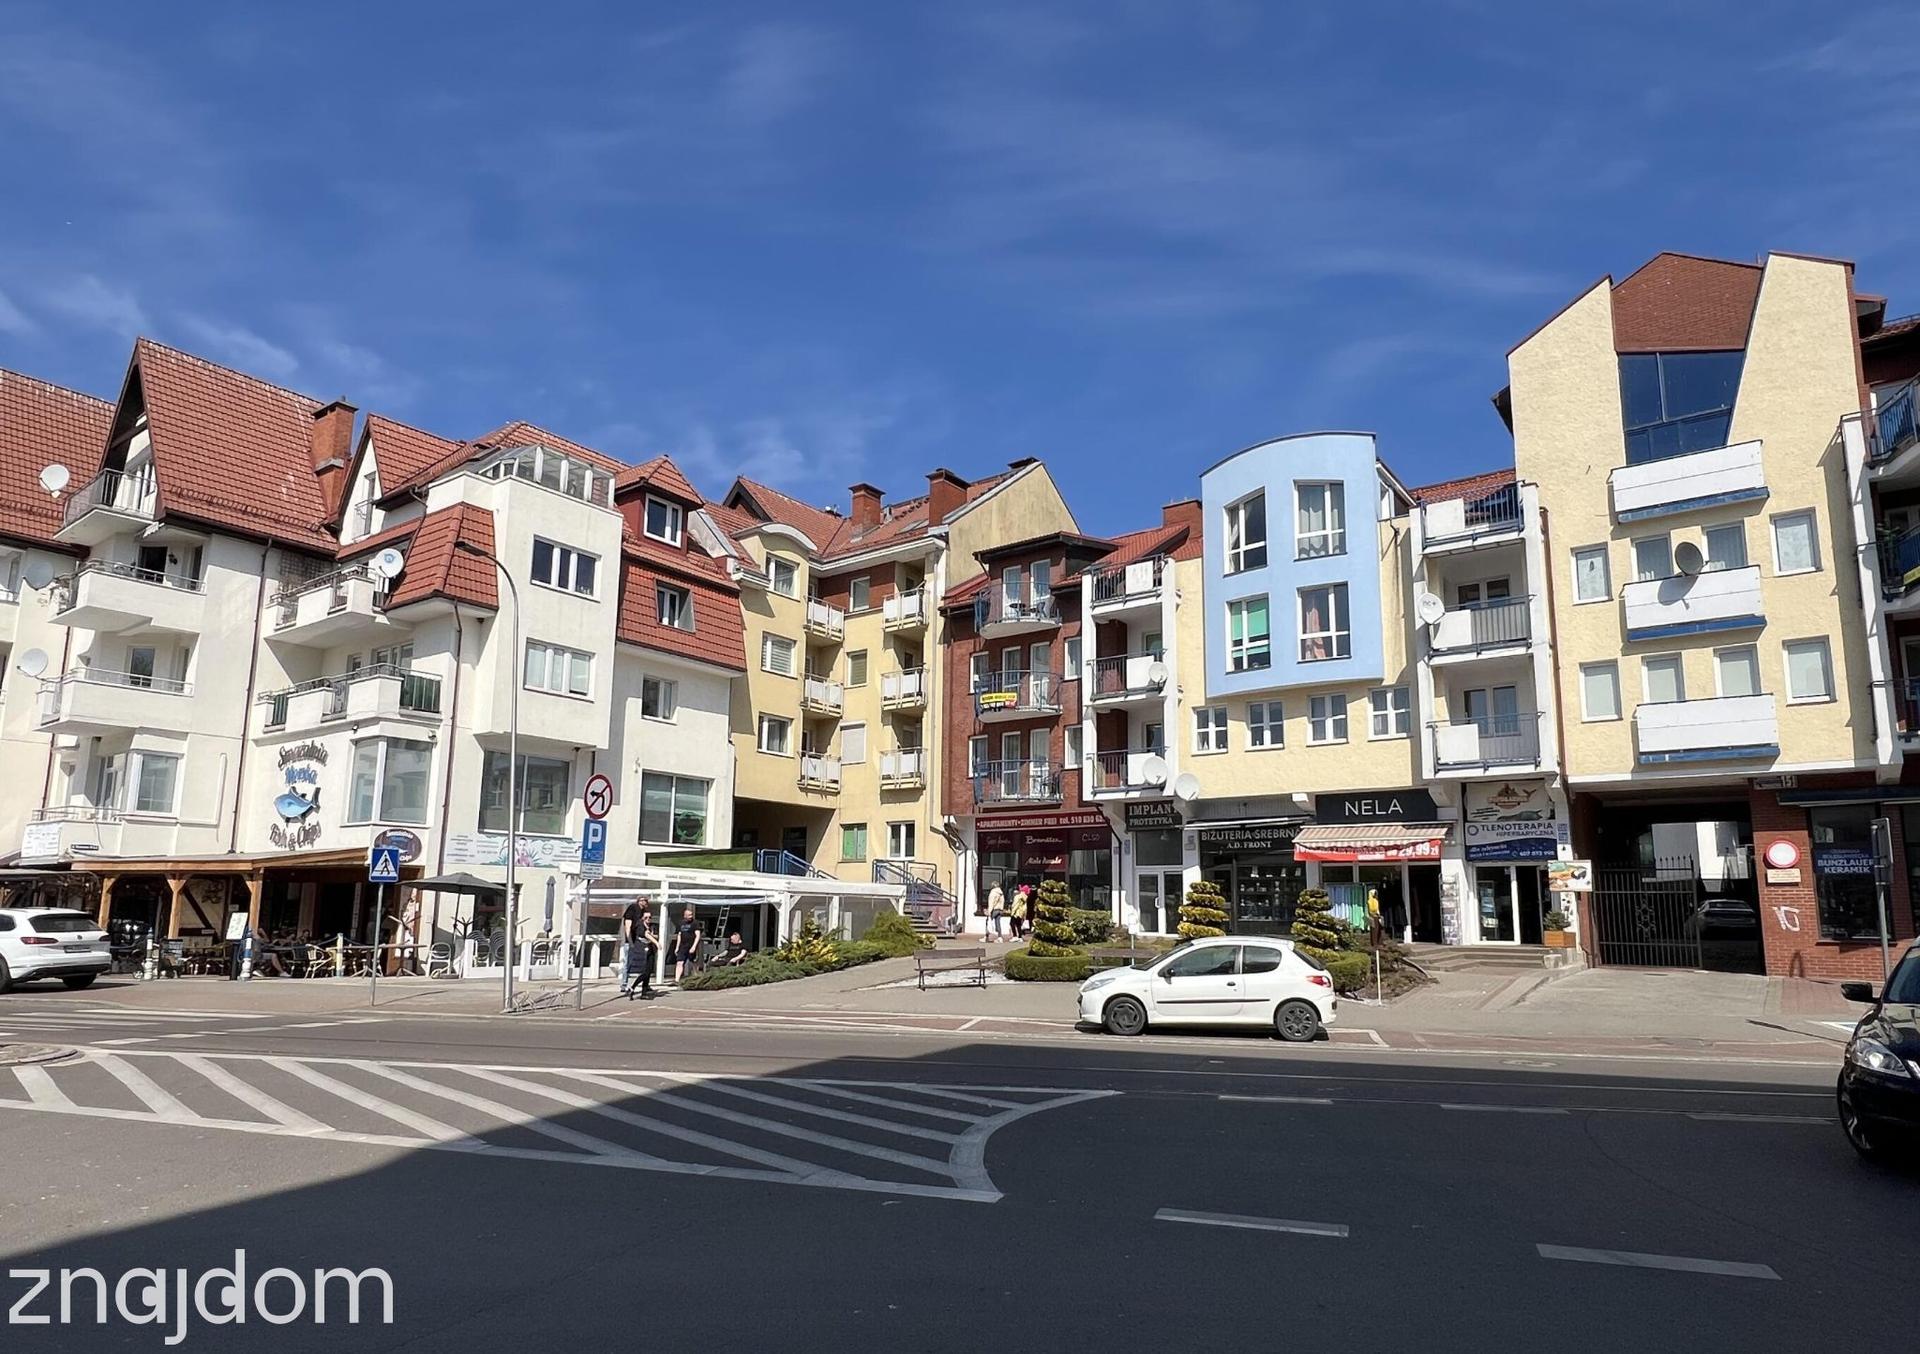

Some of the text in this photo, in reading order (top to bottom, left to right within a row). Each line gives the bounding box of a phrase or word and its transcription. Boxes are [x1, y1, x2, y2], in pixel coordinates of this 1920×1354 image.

[1345, 799, 1403, 816] NELA
[1129, 817, 1174, 826] PROTETYKA
[1480, 822, 1554, 832] TLENOTERAPIA
[588, 823, 602, 849] P
[1201, 829, 1251, 841] BIŻUTERIA
[1244, 841, 1272, 849] FRONT
[1824, 866, 1871, 874] KERAMIK
